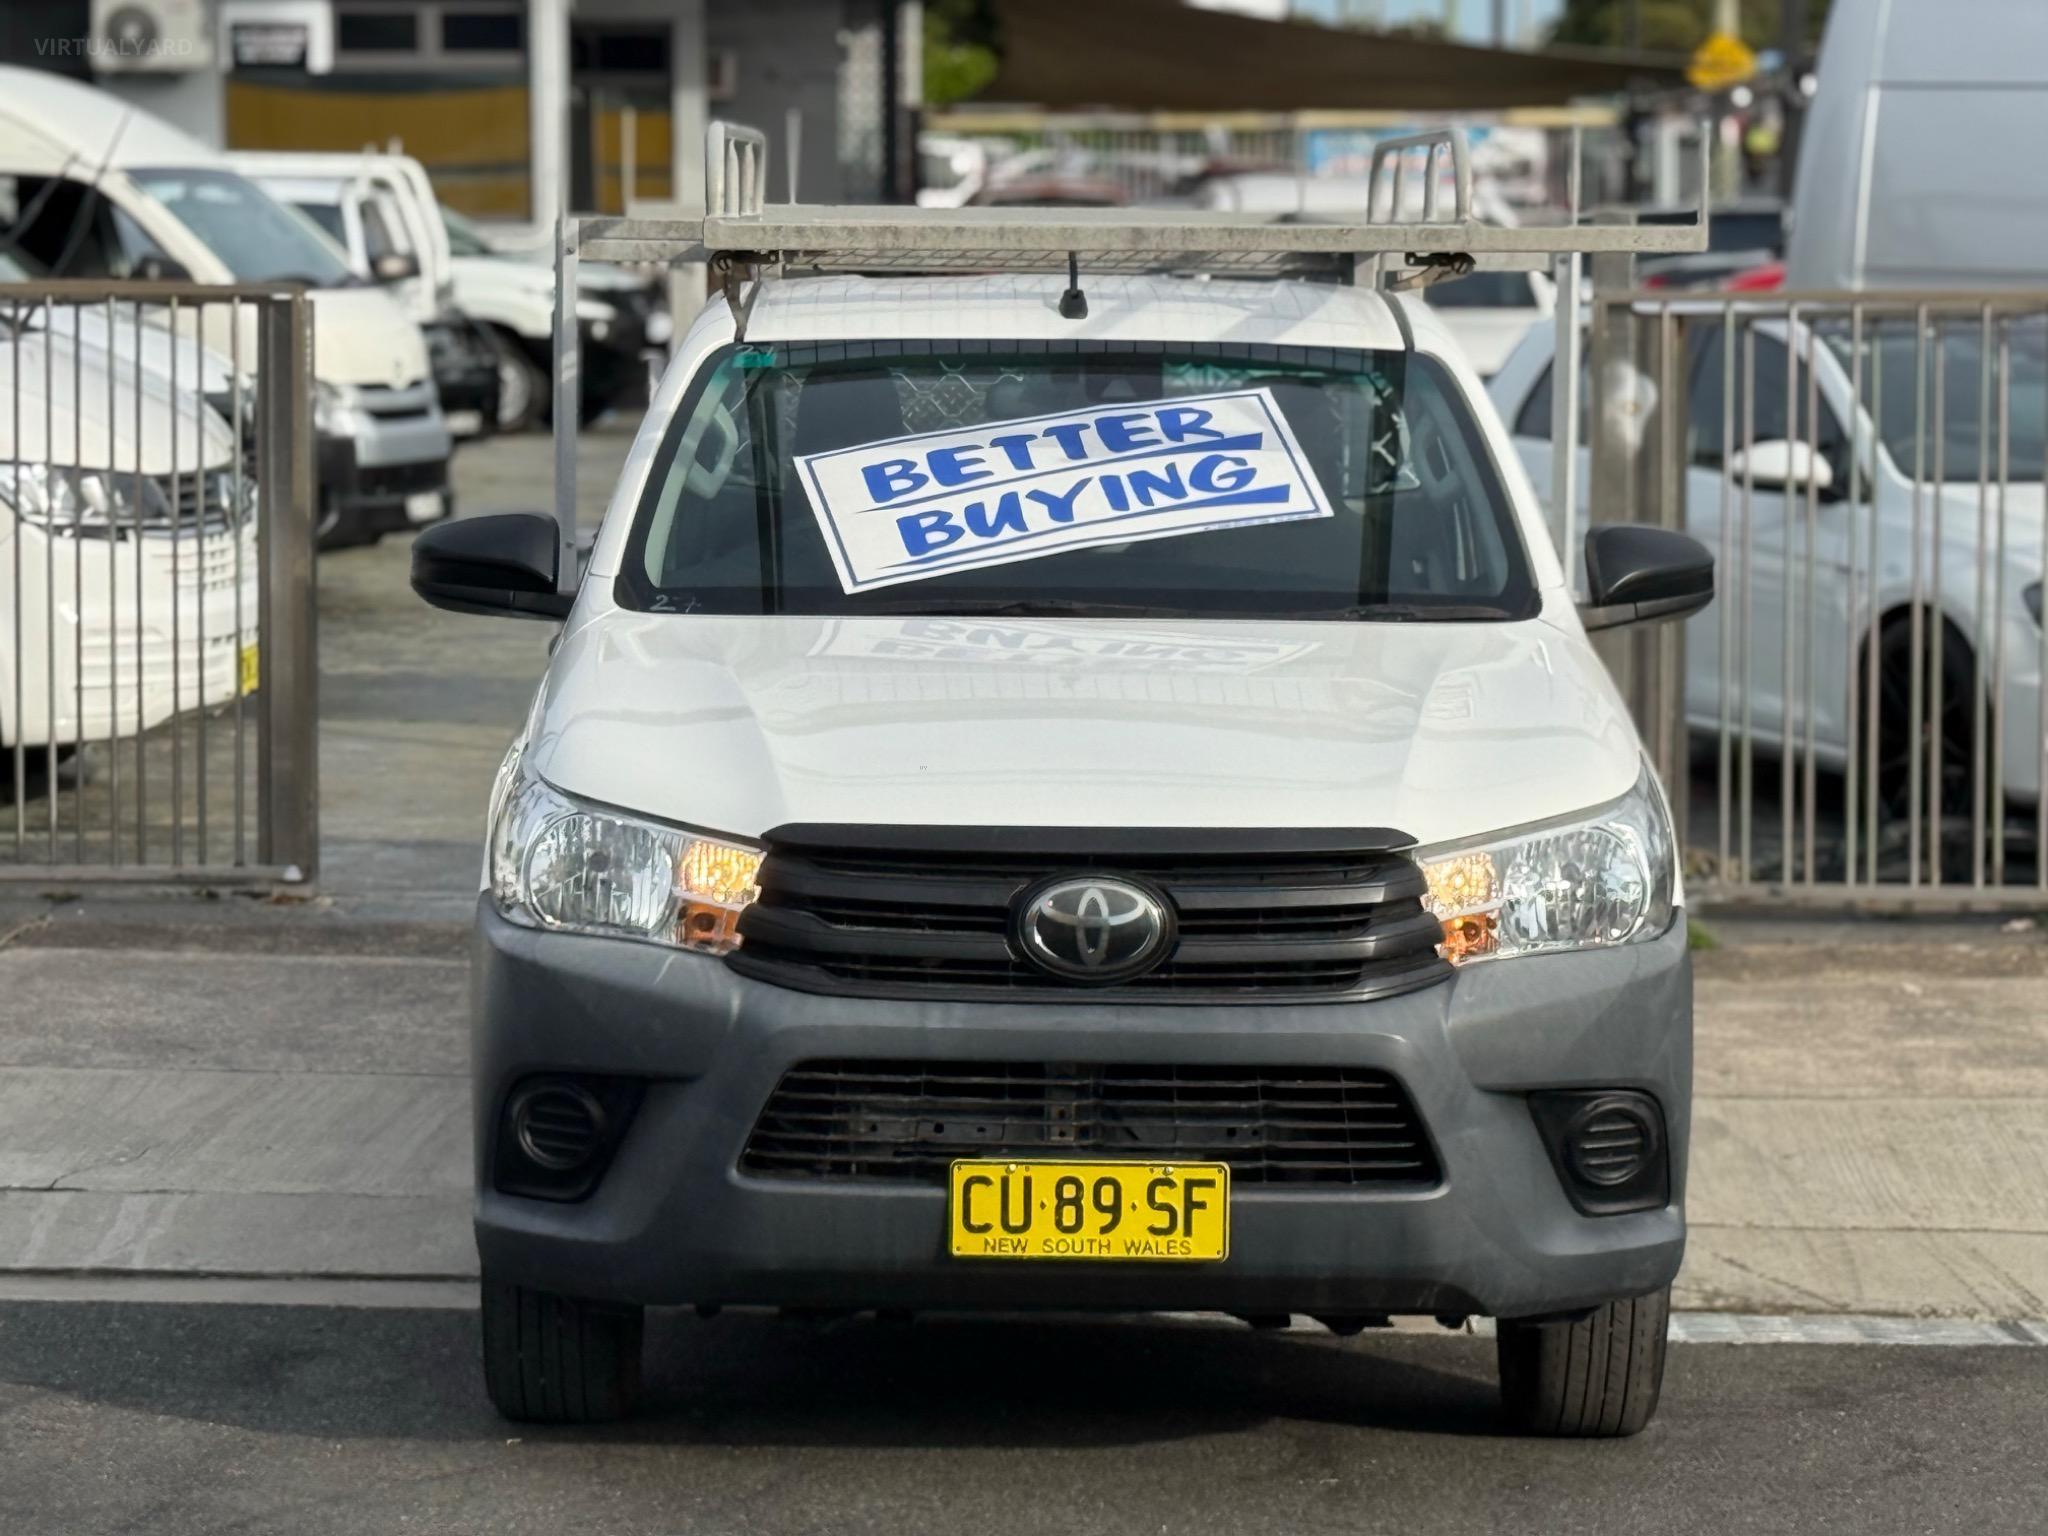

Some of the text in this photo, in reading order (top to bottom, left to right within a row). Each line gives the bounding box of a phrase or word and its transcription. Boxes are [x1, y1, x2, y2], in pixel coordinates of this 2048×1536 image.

[861, 407, 1225, 503] BETTER
[896, 454, 1257, 556] BUYING
[983, 1237, 1192, 1256] NEW SOUTH WALES
